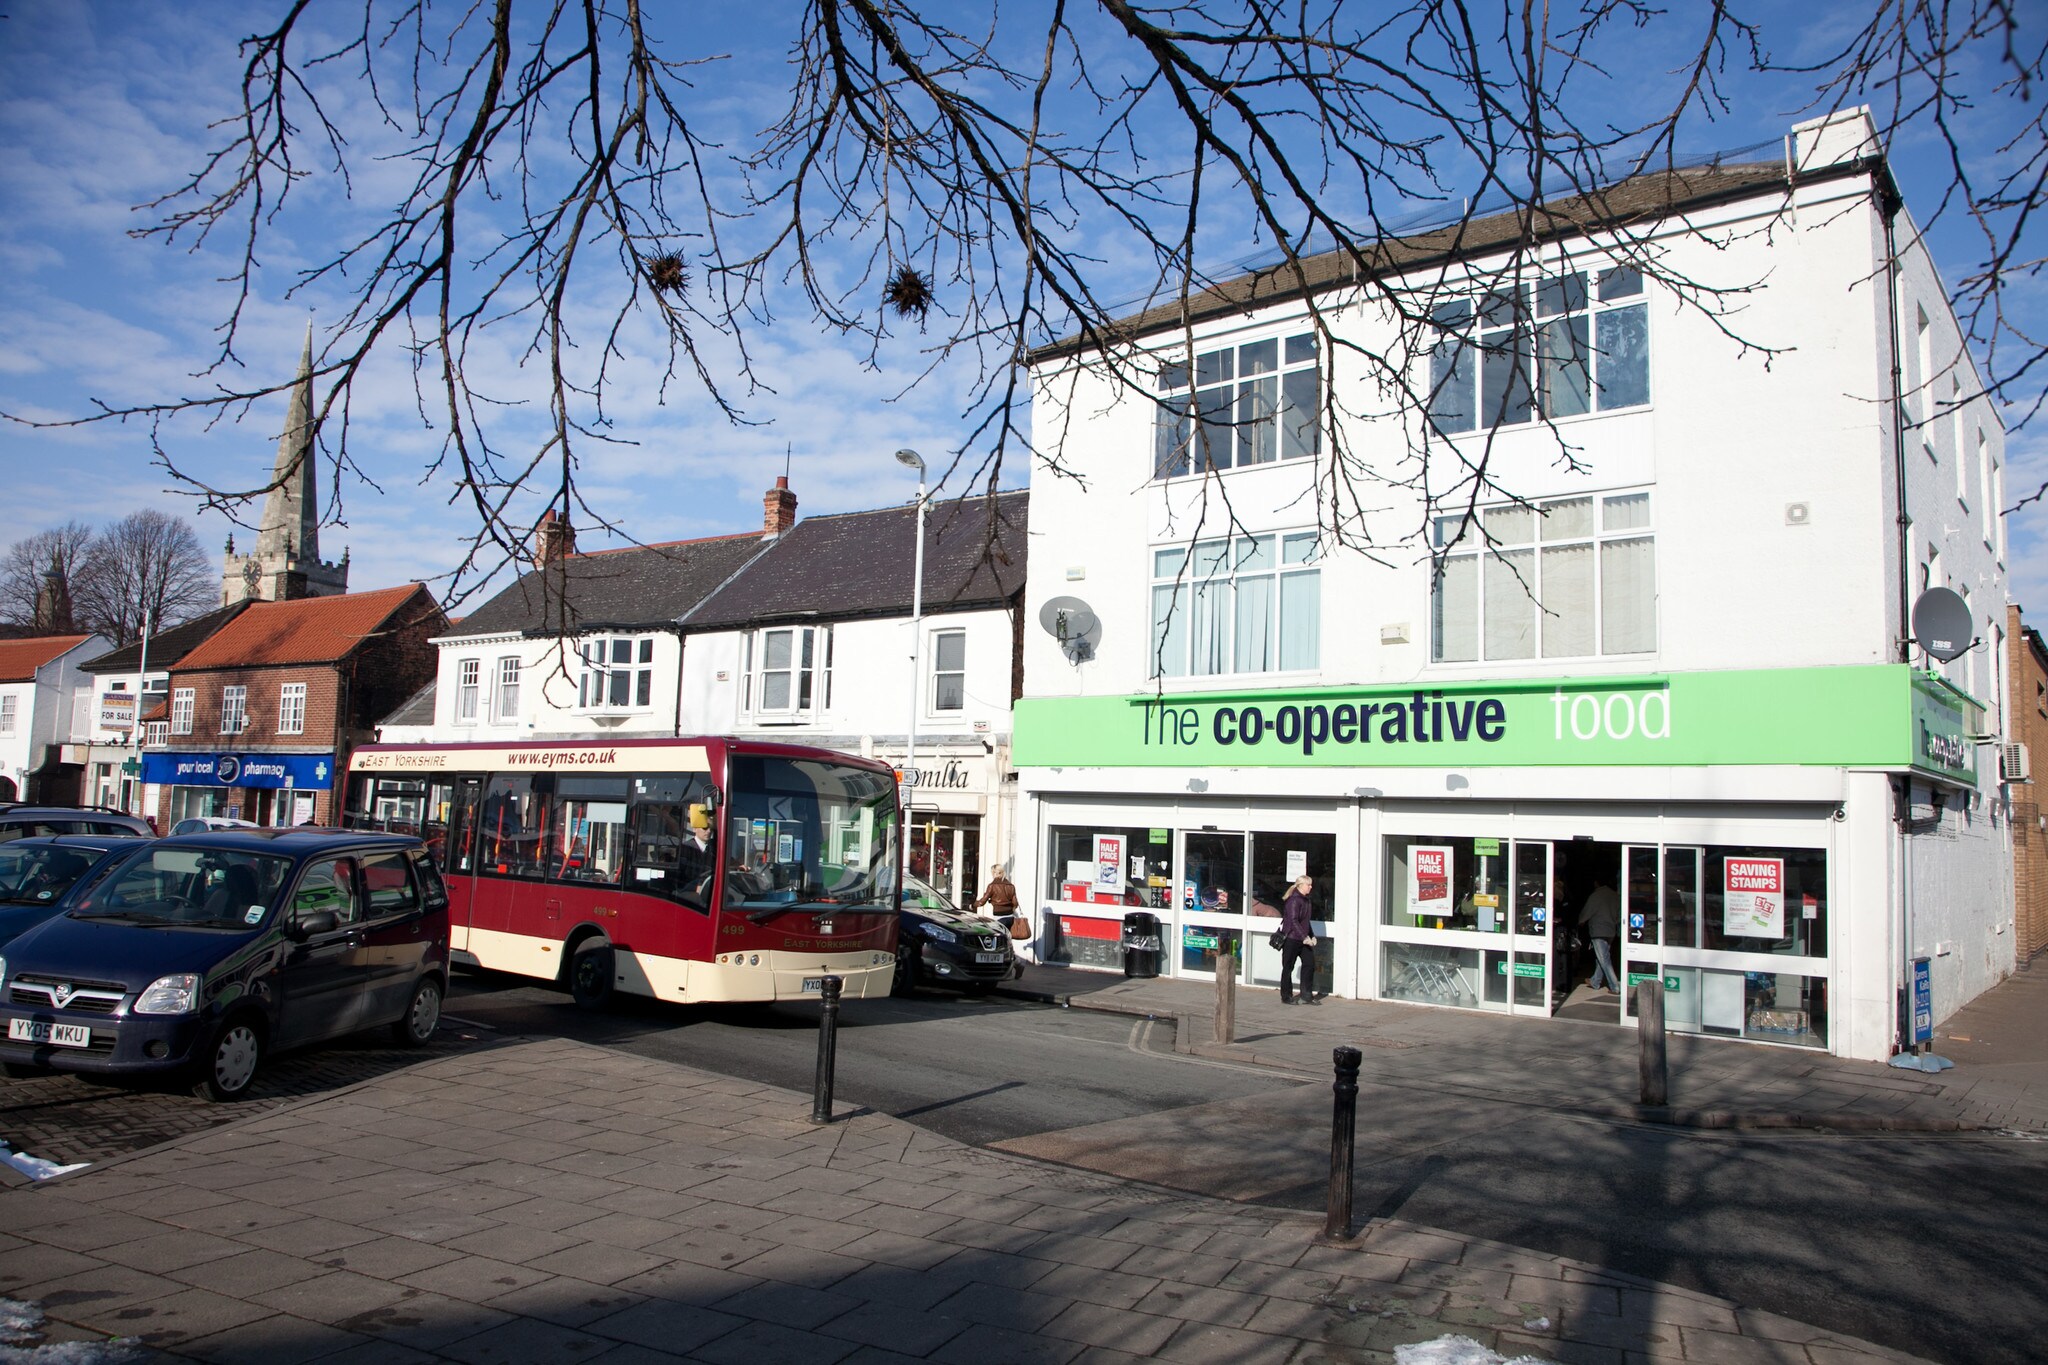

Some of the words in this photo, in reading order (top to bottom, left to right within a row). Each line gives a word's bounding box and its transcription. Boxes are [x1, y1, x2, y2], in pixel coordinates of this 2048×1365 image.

[1144, 700, 1200, 745] The
[1213, 690, 1507, 756] co-operative
[1549, 684, 1671, 740] food
[366, 755, 390, 767] EAST
[394, 754, 447, 767] YORKSHIRE
[508, 749, 617, 768] www.eyms.co.uk
[177, 762, 195, 775] your
[195, 761, 213, 774] local
[244, 761, 285, 778] pharmacy
[896, 761, 968, 788] nilla
[1100, 843, 1118, 852] HALF
[1100, 852, 1118, 860] PRICE
[1418, 854, 1442, 865] HALF
[1418, 865, 1442, 875] PRICE
[1730, 863, 1776, 877] SAVING
[1731, 877, 1777, 889] STAMPS
[593, 906, 607, 915] 499
[1763, 902, 1775, 913] £1
[722, 925, 745, 935] 499
[784, 938, 812, 948] EAST
[815, 939, 863, 949] YORKSHIRE
[17, 1020, 53, 1038] YY05
[55, 1025, 84, 1042] WKU
